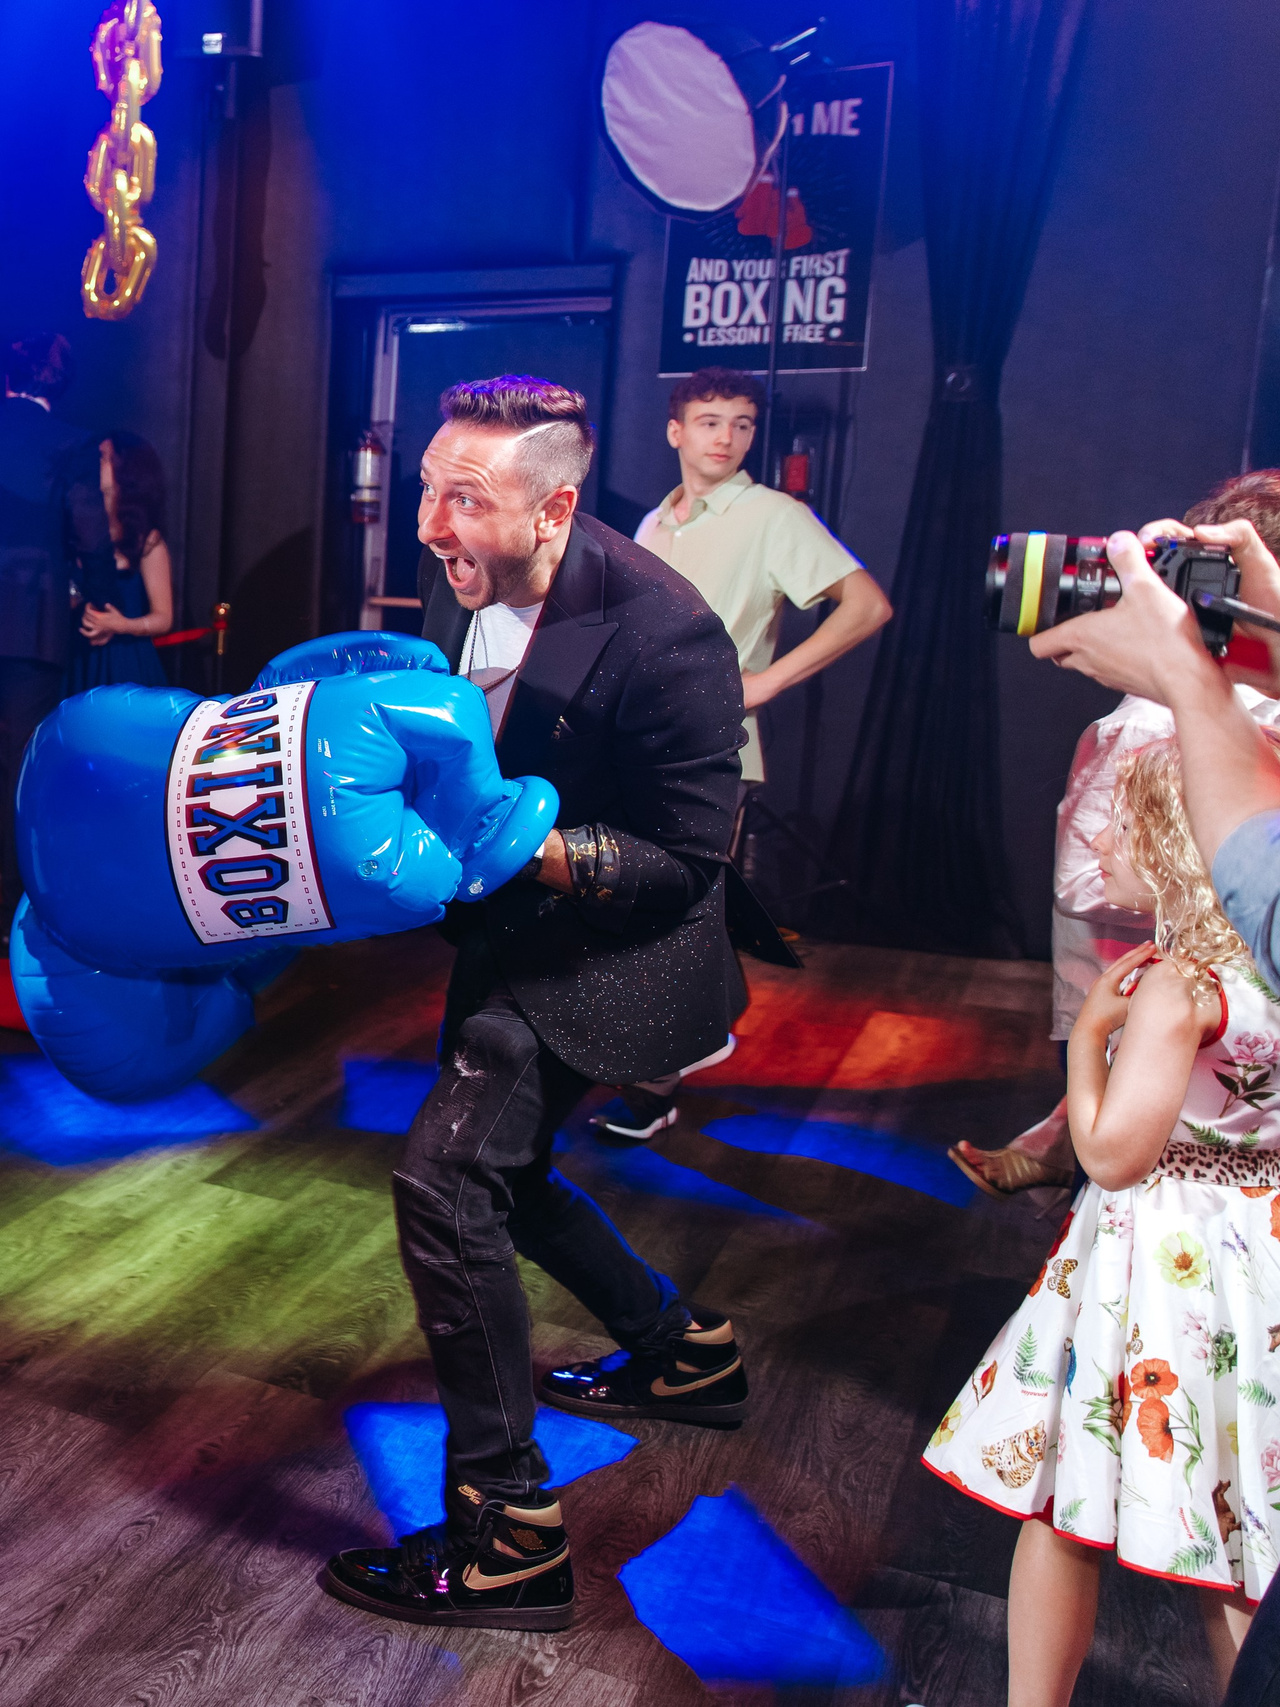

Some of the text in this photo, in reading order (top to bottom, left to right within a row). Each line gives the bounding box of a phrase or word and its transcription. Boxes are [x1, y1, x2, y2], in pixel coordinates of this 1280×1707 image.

[811, 98, 862, 136] ME
[686, 257, 728, 282] AND
[789, 248, 850, 278] FIRST
[682, 276, 846, 328] BOXNG
[697, 326, 761, 346] LESSON
[782, 323, 827, 343] FREE
[185, 692, 289, 930] BOXING
[462, 1484, 481, 1497] NIKE
